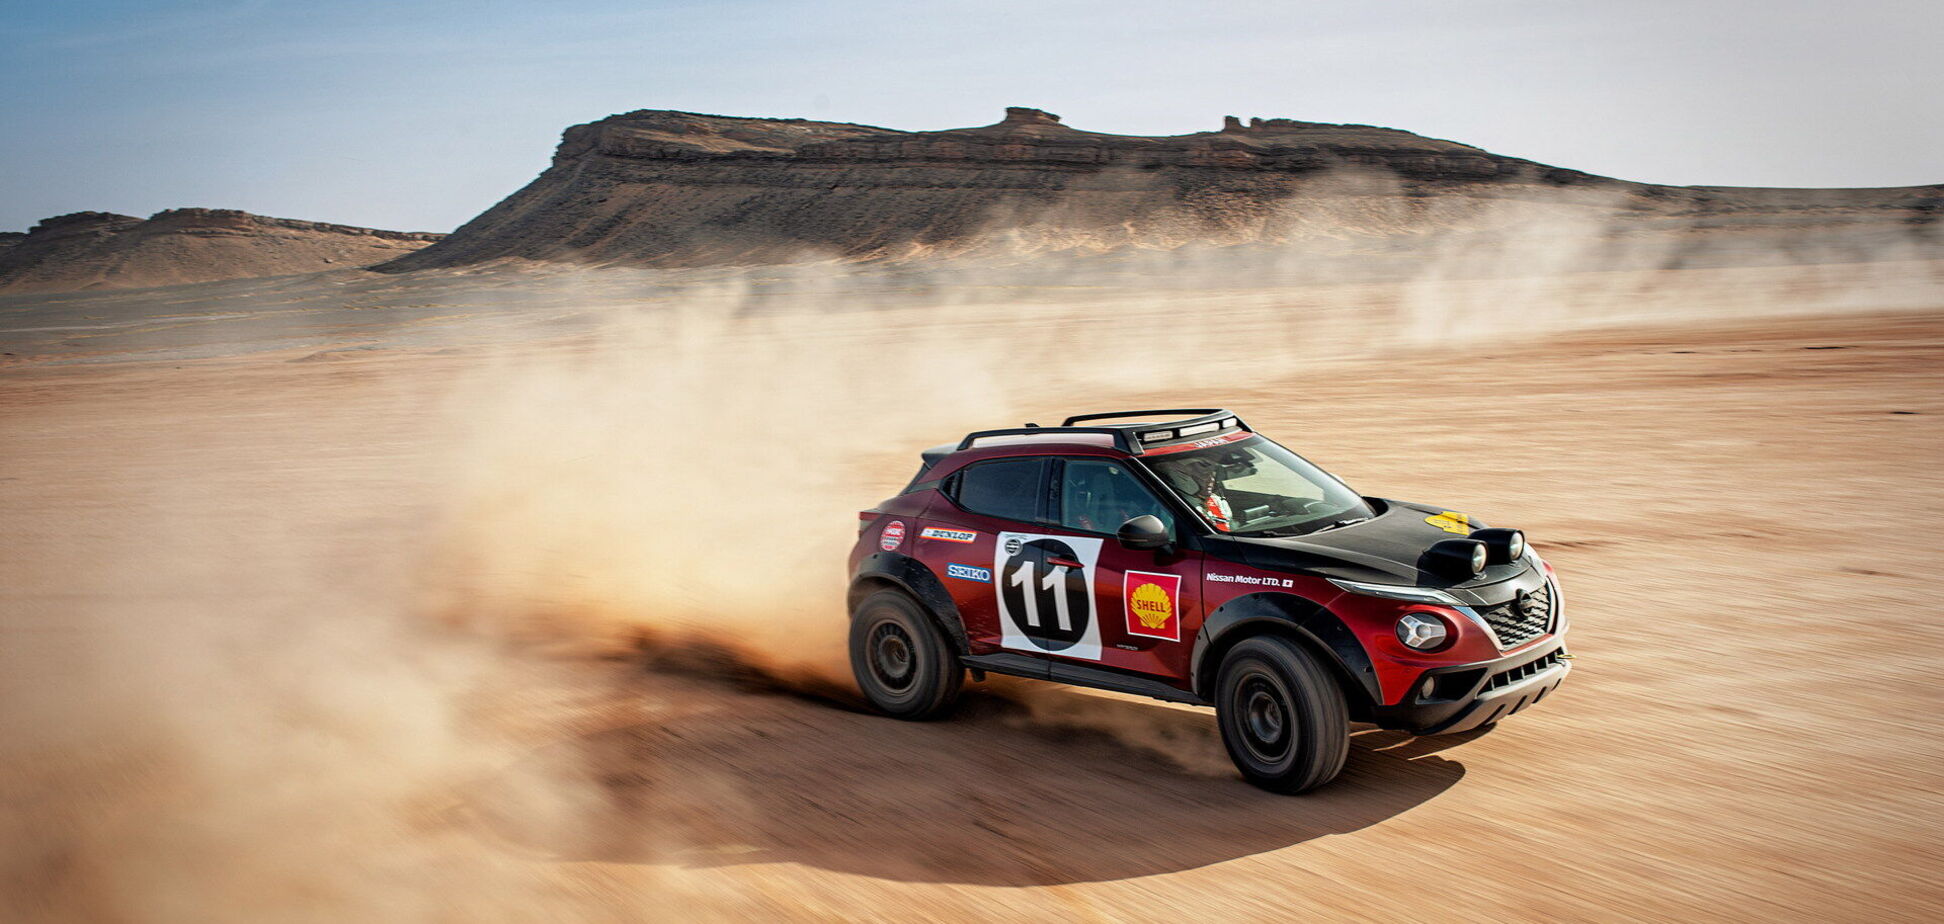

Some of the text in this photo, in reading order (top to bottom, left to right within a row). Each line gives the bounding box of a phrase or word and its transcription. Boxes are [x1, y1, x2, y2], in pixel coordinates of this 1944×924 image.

[932, 530, 973, 541] DUNLOP
[948, 565, 989, 581] SEIKO
[1206, 573, 1280, 586] Nissan Motor LTD.
[1011, 561, 1072, 631] 11
[1137, 600, 1166, 612] SHELL
